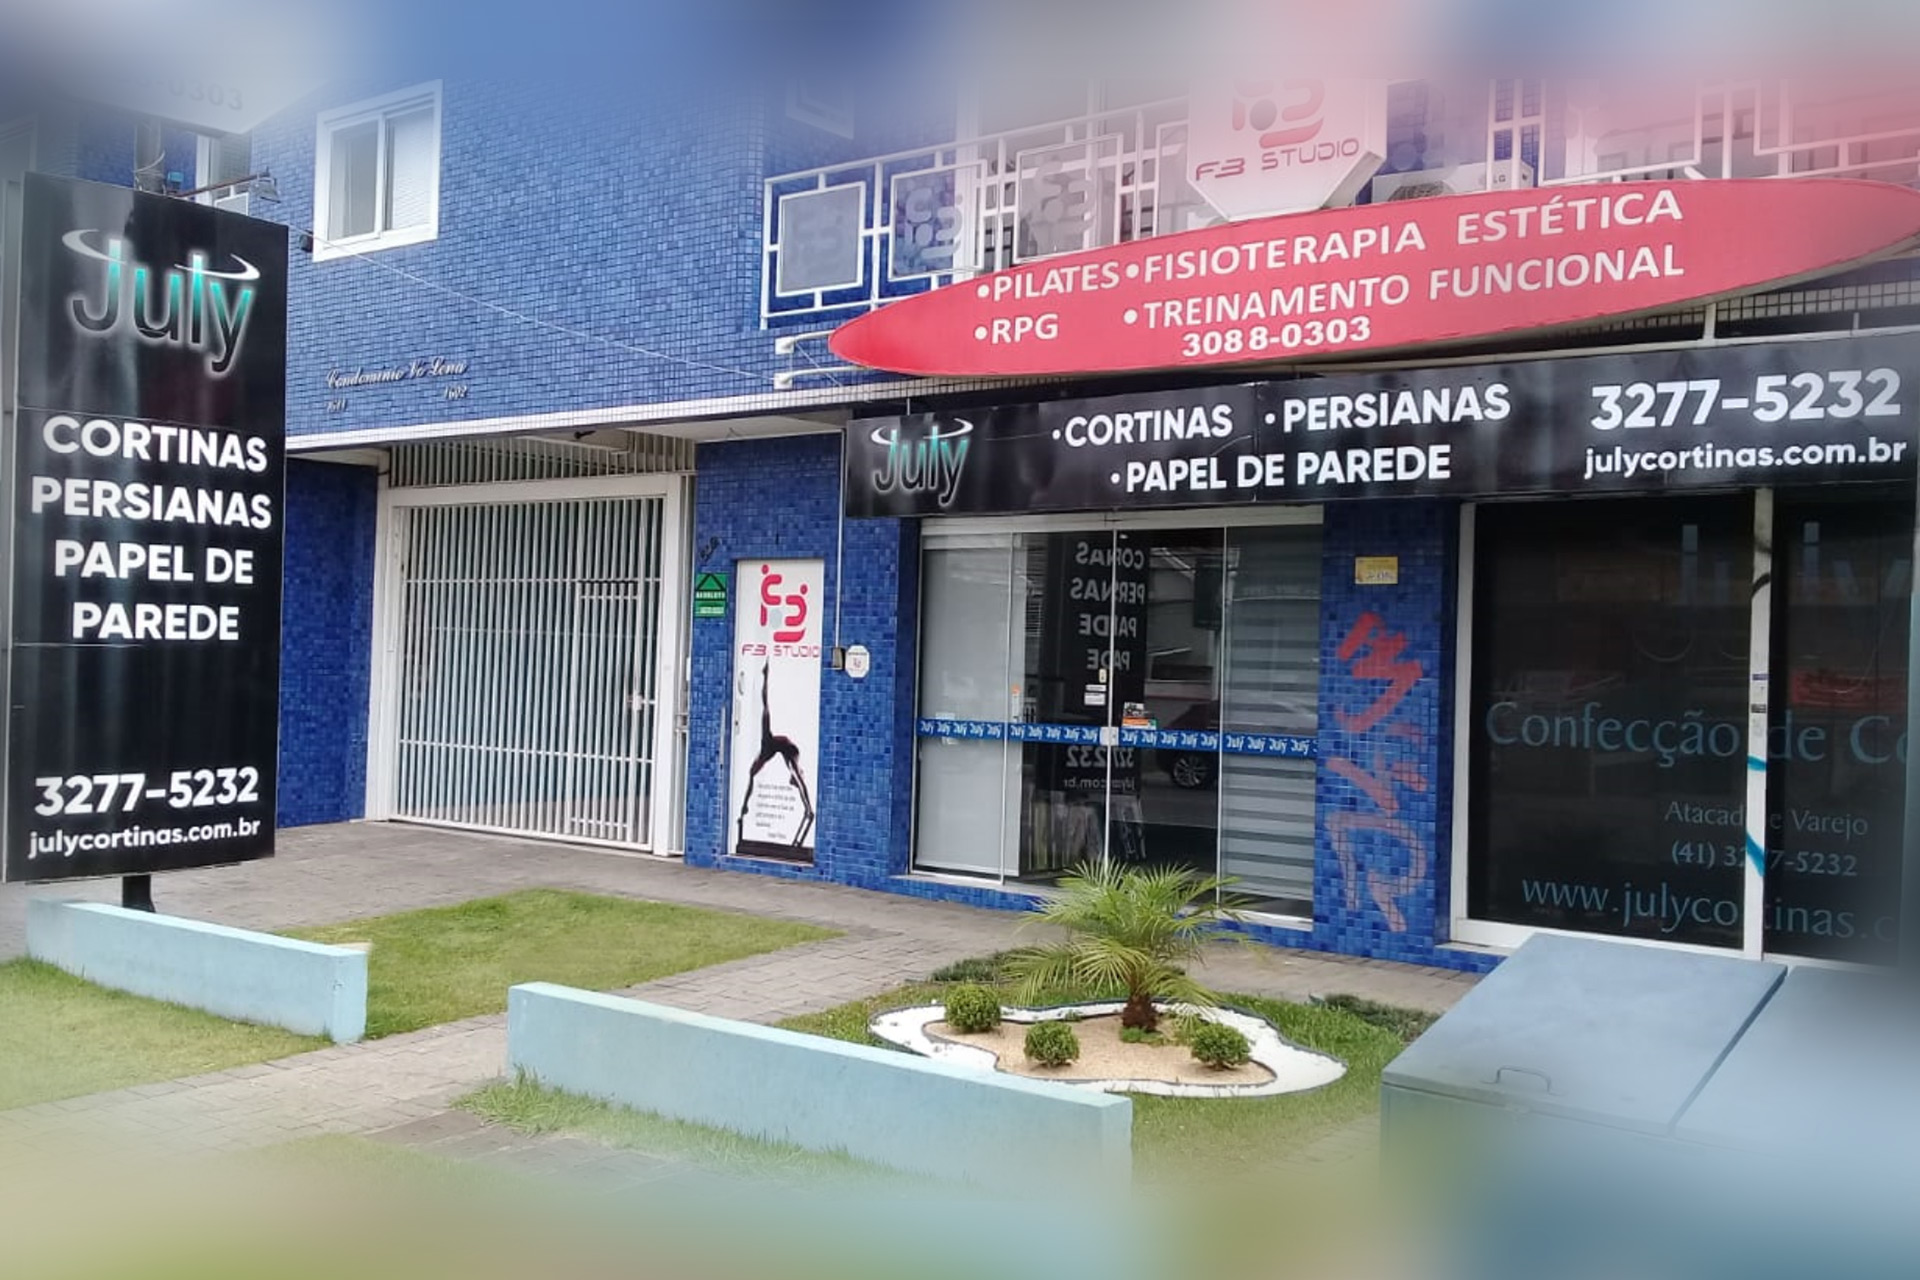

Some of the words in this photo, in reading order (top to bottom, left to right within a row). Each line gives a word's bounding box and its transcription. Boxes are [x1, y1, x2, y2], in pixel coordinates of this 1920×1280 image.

[1260, 137, 1360, 171] STUDIO
[994, 261, 1120, 301] PILATES
[1144, 222, 1426, 284] FISIOTERAPIA
[1456, 188, 1684, 246] ESTÉTICA
[69, 236, 254, 375] July
[991, 313, 1059, 345] RPG
[1144, 274, 1410, 329] TREINAMENTO
[1430, 244, 1685, 301] FUNCIONAL
[1182, 316, 1372, 357] 3088-0303
[1065, 404, 1233, 448] CORTINAS
[1283, 384, 1511, 433] PERSIANAS
[1590, 368, 1901, 430] 3277-5232
[43, 415, 268, 473] CORTINAS
[872, 425, 969, 507] July
[1126, 457, 1227, 493] PAPEL
[1237, 453, 1285, 489] DE
[1297, 444, 1452, 486] PAREDE
[1584, 436, 1907, 480] julycortinas.com.br
[31, 475, 273, 530] PERSIANAS
[54, 539, 194, 582] PAPEL
[206, 547, 254, 585] DE
[72, 601, 240, 641] PAREDE
[773, 644, 820, 658] STUDIO
[1486, 701, 1741, 768] Confecção
[1769, 710, 1826, 762] de
[34, 766, 260, 816] 3277-5232
[28, 817, 261, 860] julycortinas.com.br
[1663, 801, 1746, 827] Atacad
[1790, 809, 1869, 841] Varejo
[1671, 840, 1716, 869] (41)
[1723, 844, 1858, 877] 37-5232
